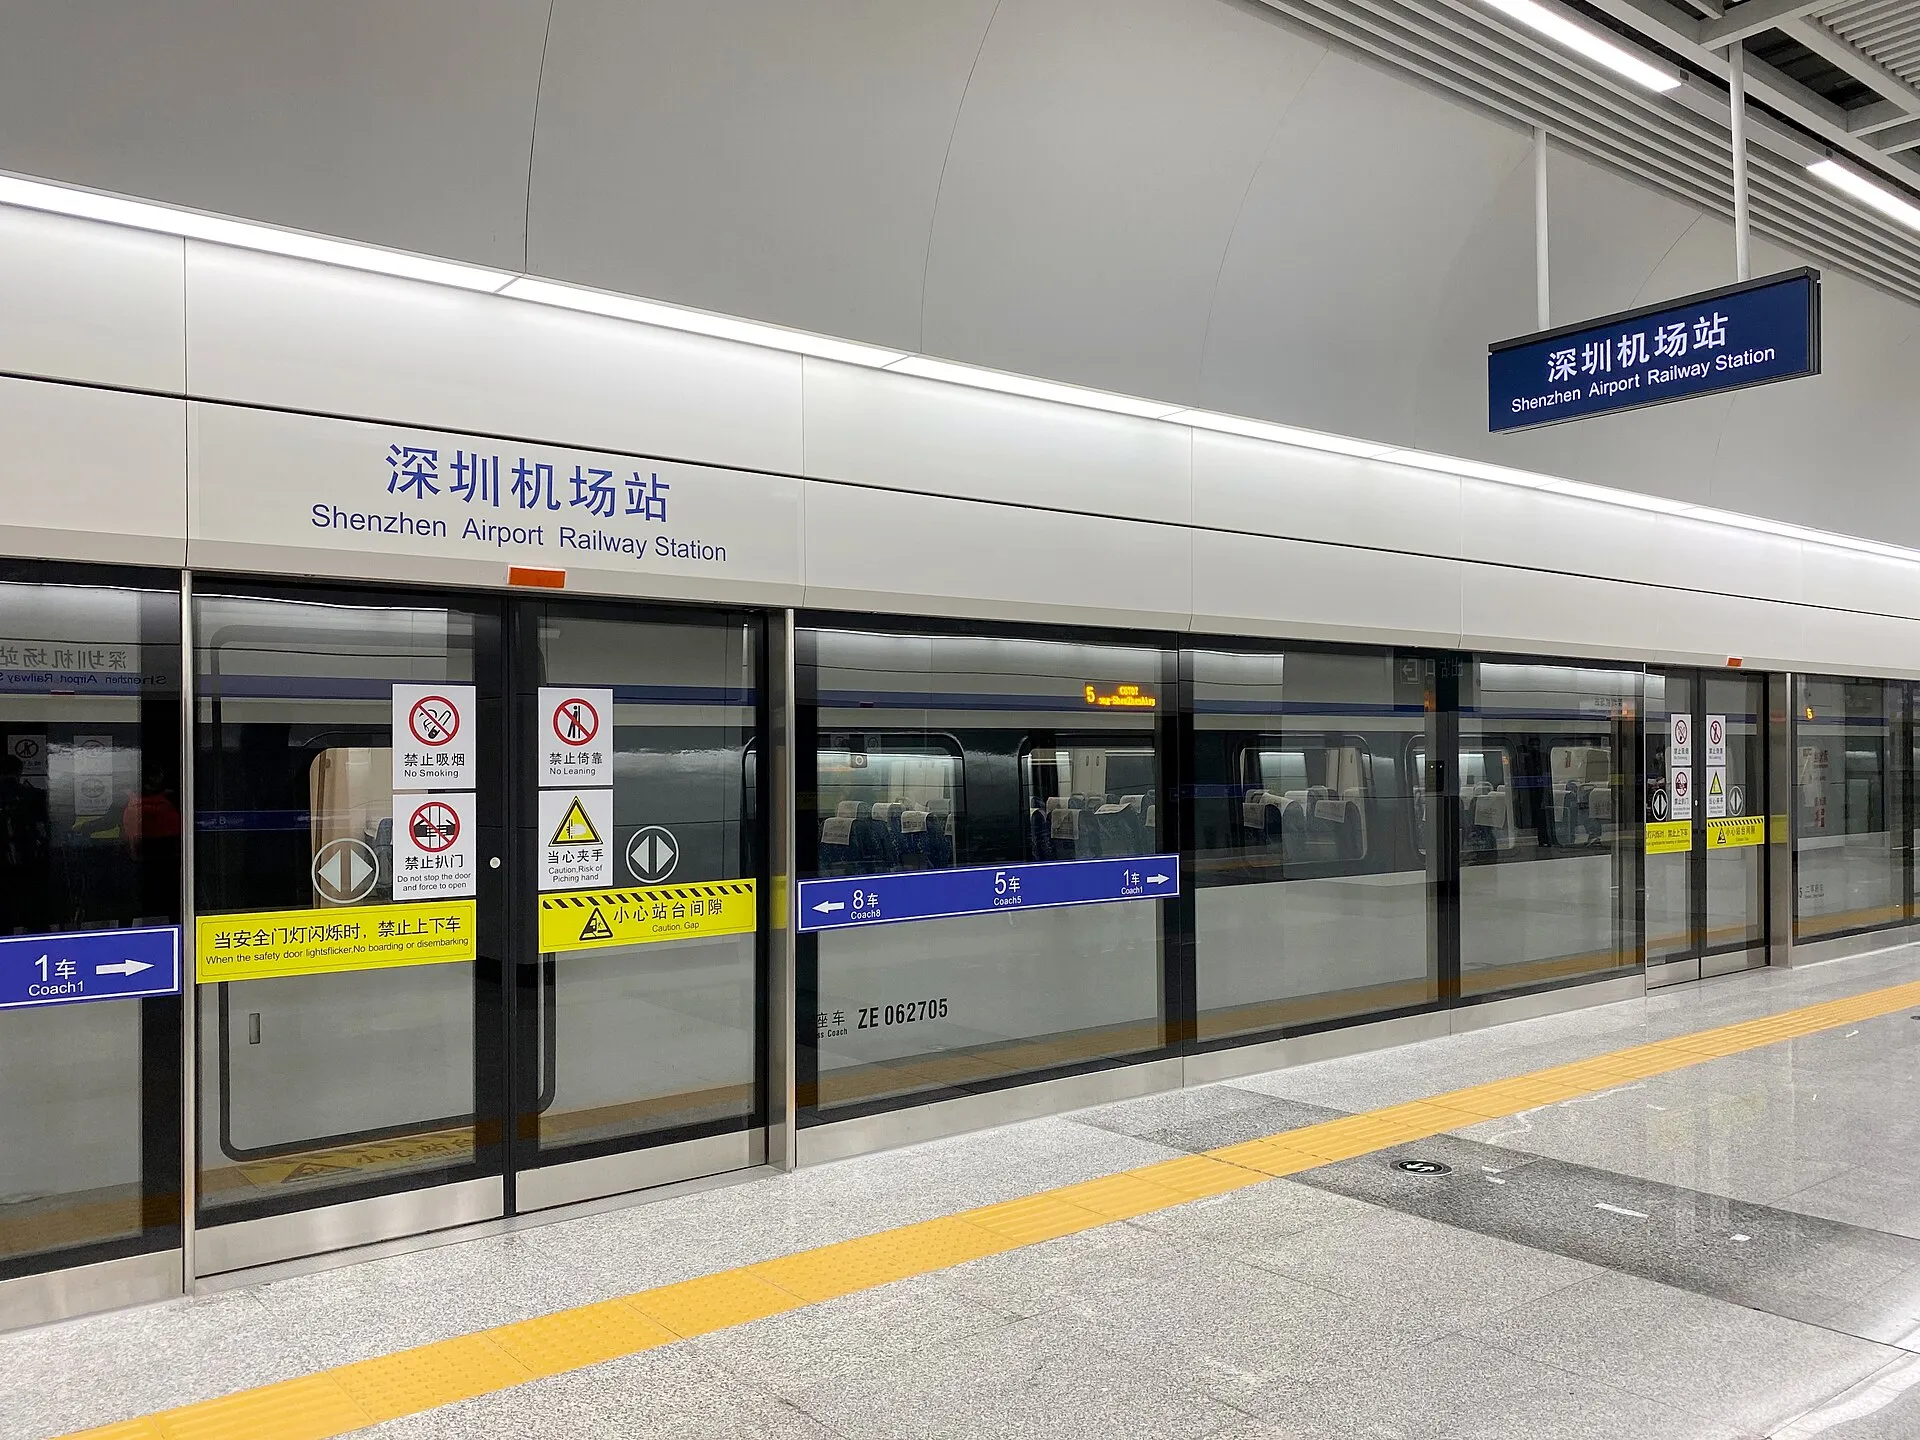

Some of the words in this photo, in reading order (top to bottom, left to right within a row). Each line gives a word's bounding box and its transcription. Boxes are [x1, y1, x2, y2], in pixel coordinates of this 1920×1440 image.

[1547, 312, 1729, 383] 深圳机场站
[1511, 388, 1581, 413] Shenzhen
[1588, 373, 1640, 397] Airport
[1647, 361, 1710, 385] Railway
[1715, 348, 1775, 371] Station
[385, 443, 670, 523] 深圳机场站
[311, 503, 447, 538] Shenzhen
[461, 518, 544, 548] Airport
[559, 526, 648, 560] Railway
[655, 535, 727, 562] Station
[1085, 686, 1096, 703] 5
[404, 752, 465, 767] 禁止吸烟
[549, 752, 603, 766] 禁止倚靠
[404, 769, 417, 778] No
[419, 769, 459, 779] Smoking
[549, 767, 562, 775] No
[563, 767, 596, 776] Leaning
[404, 854, 464, 871] 禁止扒门
[547, 848, 604, 865] 当心夹手
[595, 863, 603, 872] of
[397, 875, 409, 883] Do
[410, 874, 422, 882] not
[424, 874, 440, 883] stop
[454, 872, 472, 880] door
[552, 874, 580, 883] Piching
[580, 873, 599, 881] hand
[994, 871, 1020, 895] 5车
[1123, 869, 1140, 886] 1车
[402, 884, 417, 892] and
[419, 883, 437, 891] force
[439, 882, 447, 890] to
[448, 882, 467, 891] open
[1121, 885, 1143, 895] Coach1
[853, 889, 879, 910] 8车
[993, 895, 1022, 906] Coach5
[613, 898, 723, 924] 小心站台间隙
[850, 909, 881, 920] Coach8
[684, 921, 700, 931] Gap
[205, 955, 234, 965] When
[236, 953, 251, 962] the
[253, 951, 280, 962] safety
[283, 949, 303, 959] door
[368, 942, 404, 952] boarding
[406, 941, 415, 949] or
[416, 937, 469, 948] disembarking
[34, 954, 77, 982] 1车
[28, 980, 84, 997] Coach1
[857, 1006, 880, 1030] ZE
[884, 998, 949, 1026] 062705
[827, 1028, 848, 1038] Coach
